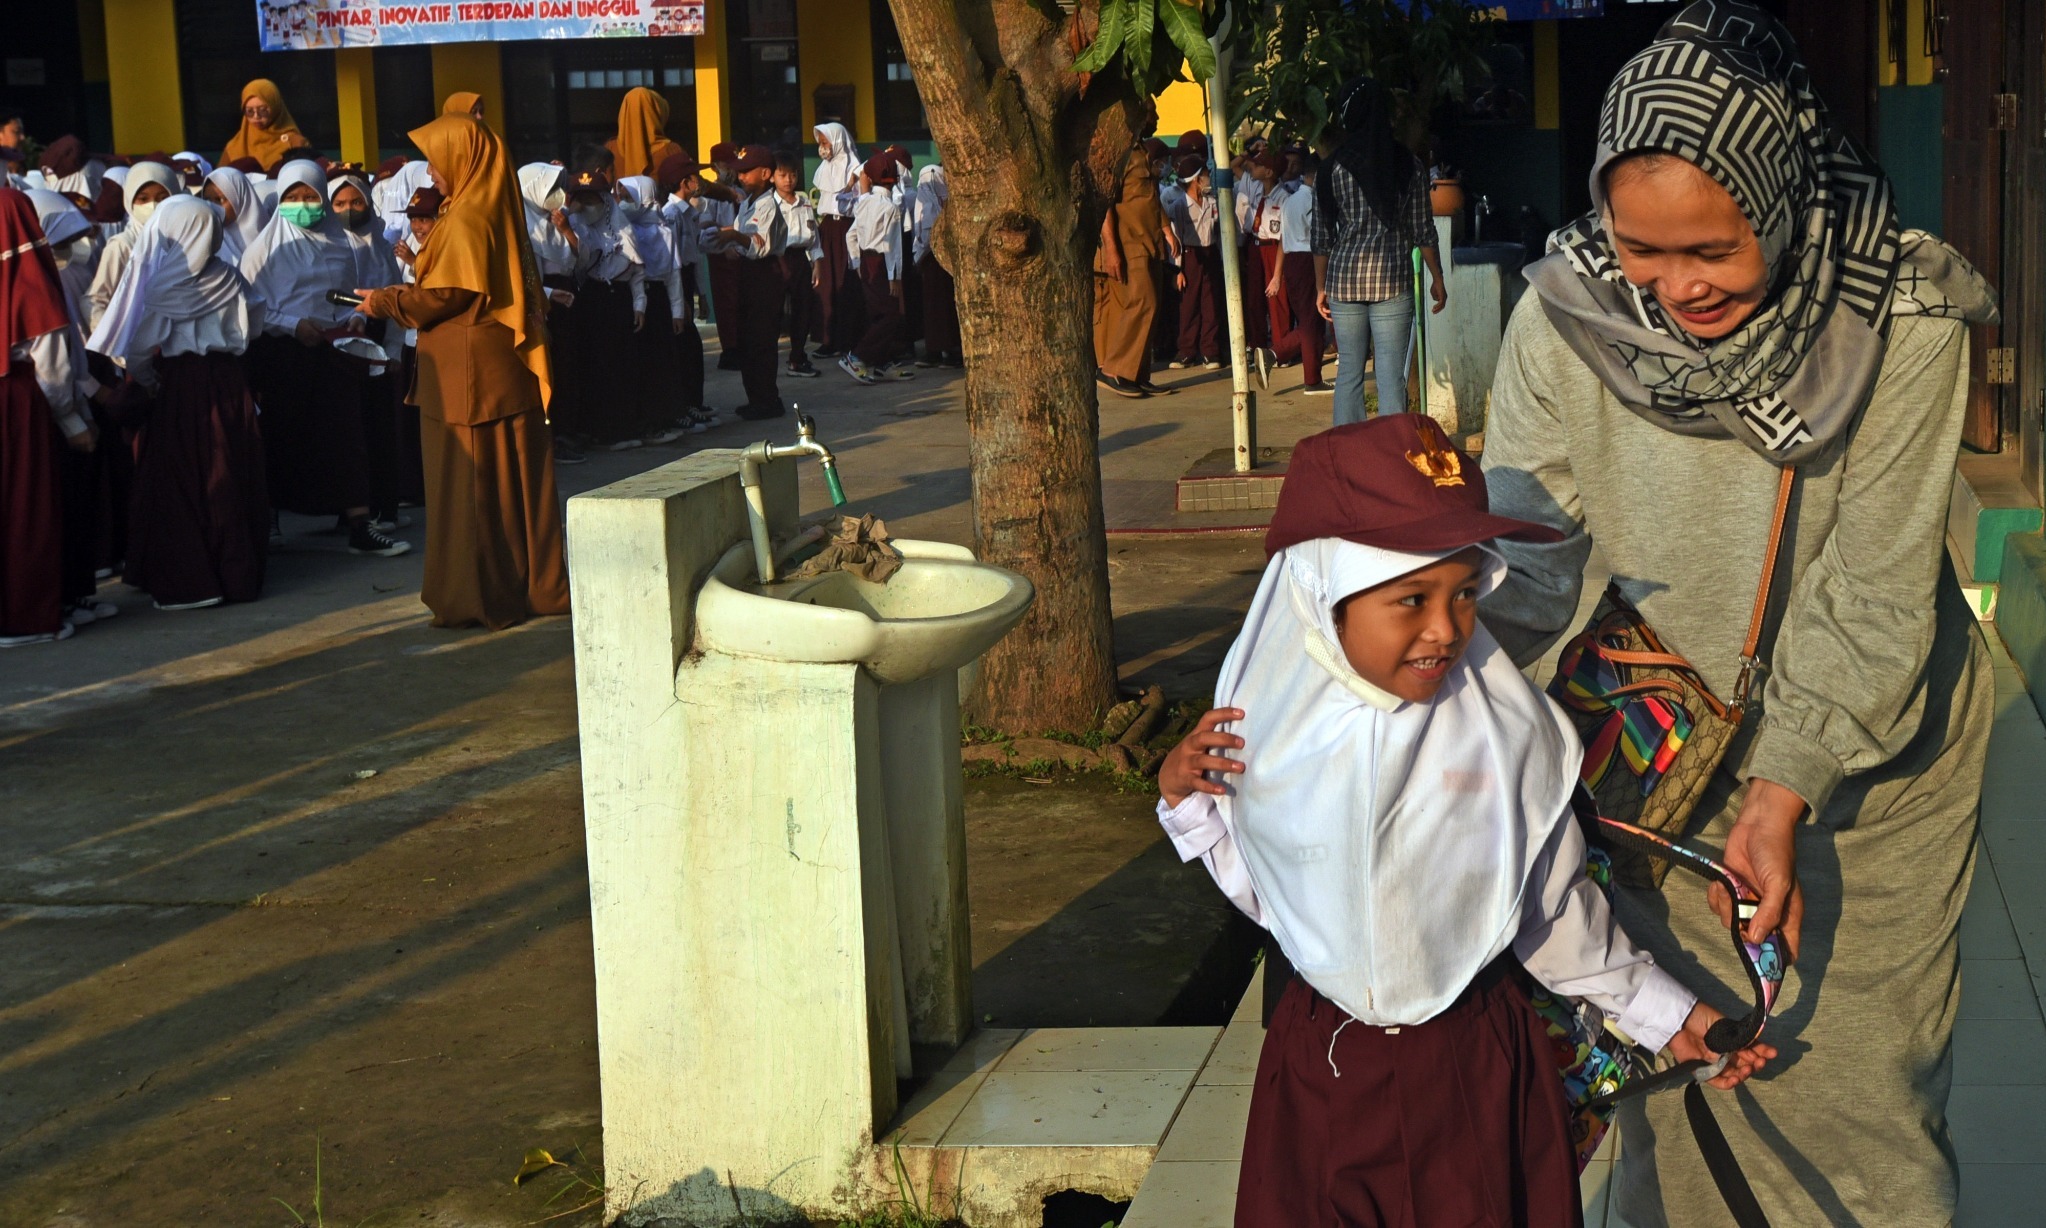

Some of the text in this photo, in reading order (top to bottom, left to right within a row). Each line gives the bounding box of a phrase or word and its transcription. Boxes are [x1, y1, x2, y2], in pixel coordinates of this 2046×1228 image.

[316, 0, 640, 28] PINTAR, INOVATIF, TERDEPAN DAN UNGGUL
